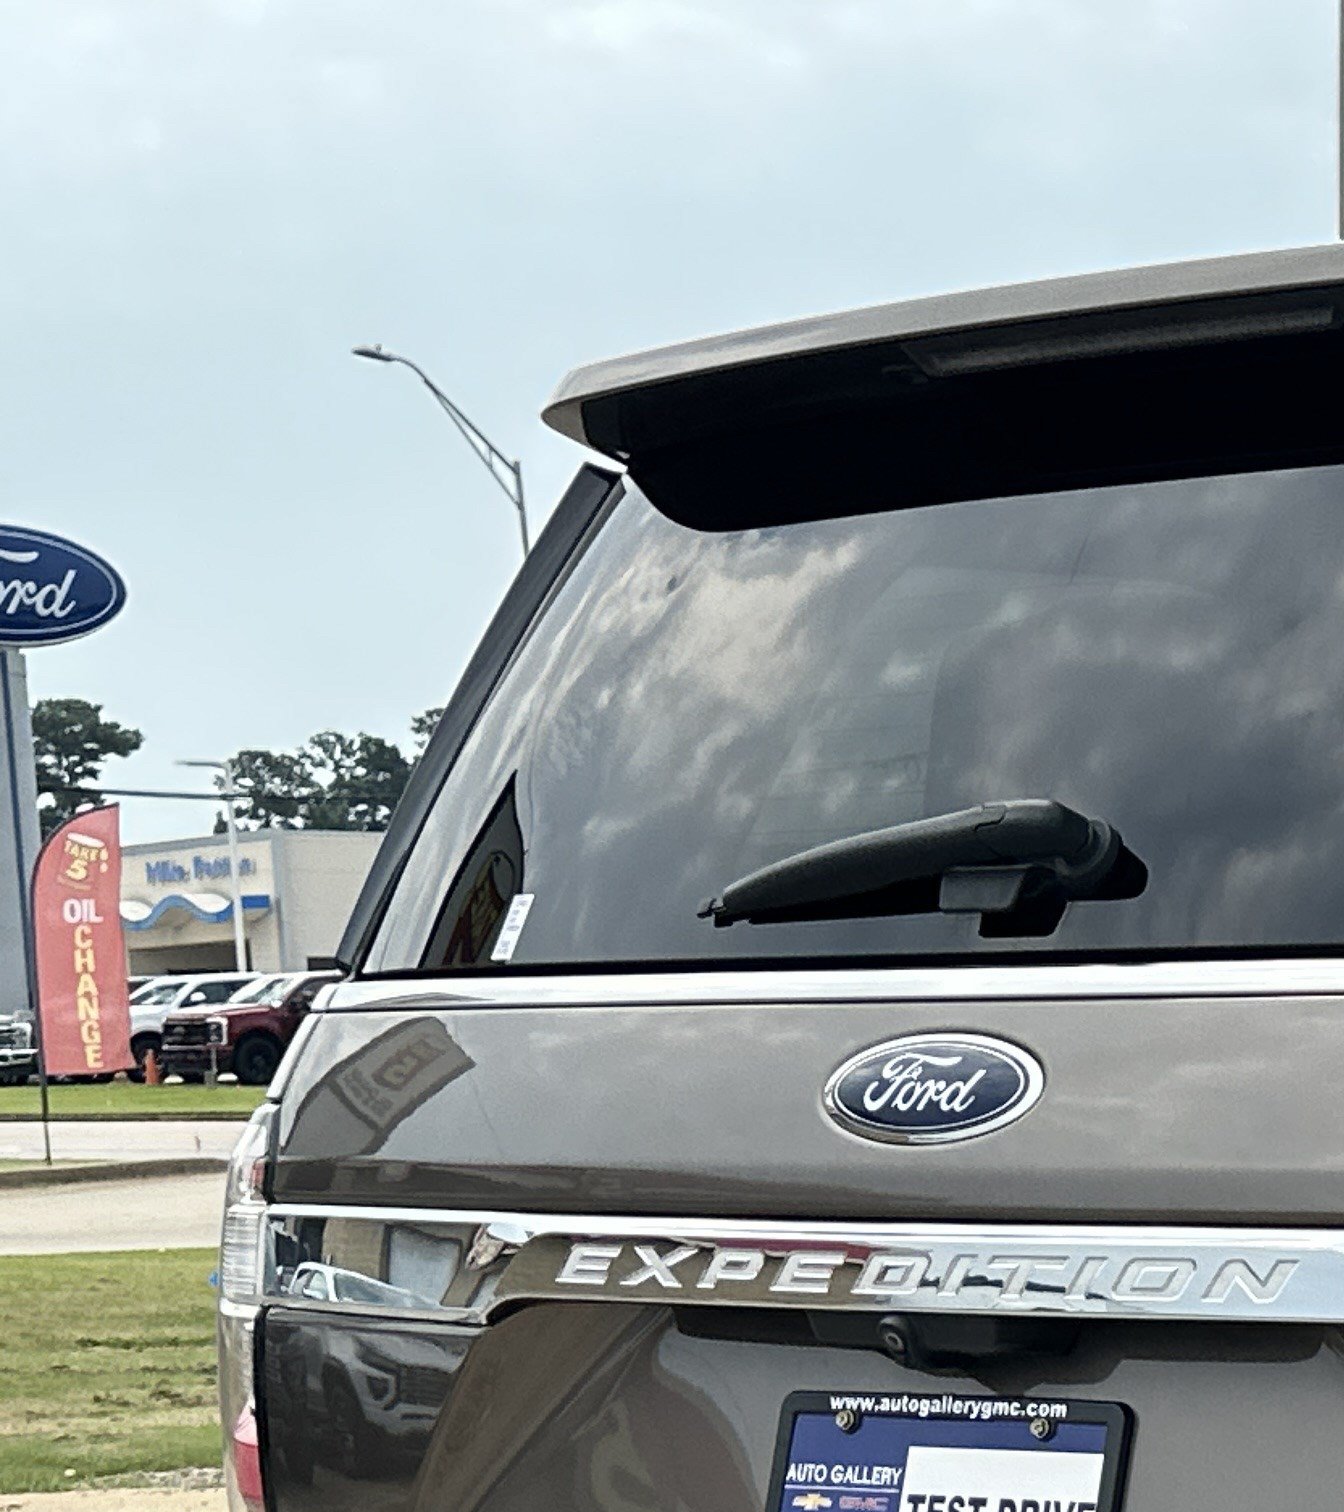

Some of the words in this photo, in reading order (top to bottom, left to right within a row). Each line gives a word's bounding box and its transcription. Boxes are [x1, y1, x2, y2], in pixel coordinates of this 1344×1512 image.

[63, 839, 99, 862] TAKE
[65, 858, 88, 881] 5
[63, 898, 104, 924] OIL
[73, 925, 104, 1069] CHANGE
[863, 1052, 987, 1112] Ford
[553, 1242, 1304, 1306] EXPEDITION
[830, 1396, 1068, 1419] www.autogallerygmc.com
[786, 1463, 828, 1482] AUTO
[830, 1465, 903, 1486] GALLERY
